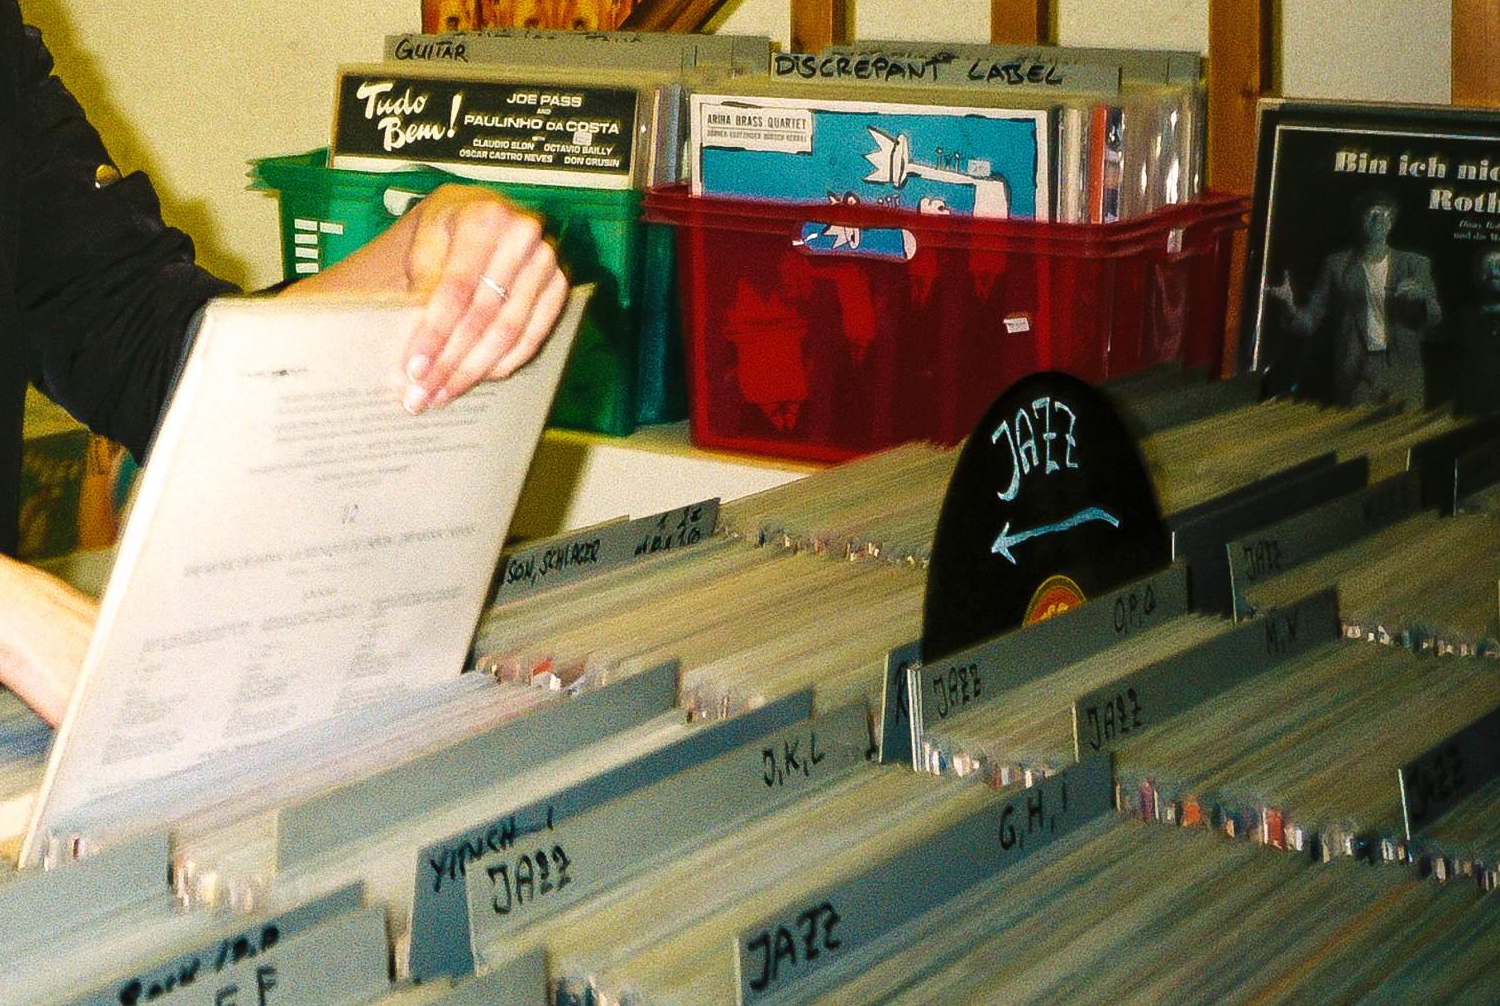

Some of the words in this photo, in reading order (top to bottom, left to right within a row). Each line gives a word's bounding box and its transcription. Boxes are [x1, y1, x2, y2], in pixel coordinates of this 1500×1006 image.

[395, 40, 469, 63] GUITAR
[774, 52, 954, 82] DISCREPANT
[968, 60, 1063, 86] LABEL
[356, 81, 428, 120] Tudo
[506, 93, 537, 106] JOE
[540, 94, 582, 108] PASS
[464, 115, 543, 130] PAULINHO
[546, 121, 564, 132] DA
[566, 121, 619, 135] COSTA
[735, 115, 763, 127] BRASS
[767, 116, 807, 130] QUARTET
[459, 149, 488, 159] OSCAR
[489, 150, 523, 161] CASTRO
[524, 153, 553, 164] NEVES
[564, 155, 585, 166] DON
[585, 157, 620, 168] GRUSIN
[473, 138, 509, 149] CLAUDIO
[511, 141, 535, 151] SLON
[543, 143, 580, 154] OCTAVIO
[1334, 151, 1388, 174] Bin
[1398, 154, 1447, 178] ich
[992, 397, 1079, 501] JAZZ
[932, 662, 983, 719] JAZZ
[1086, 688, 1143, 751] JAZZ
[487, 846, 572, 914] JAZZ
[748, 903, 842, 991] JAZZ
